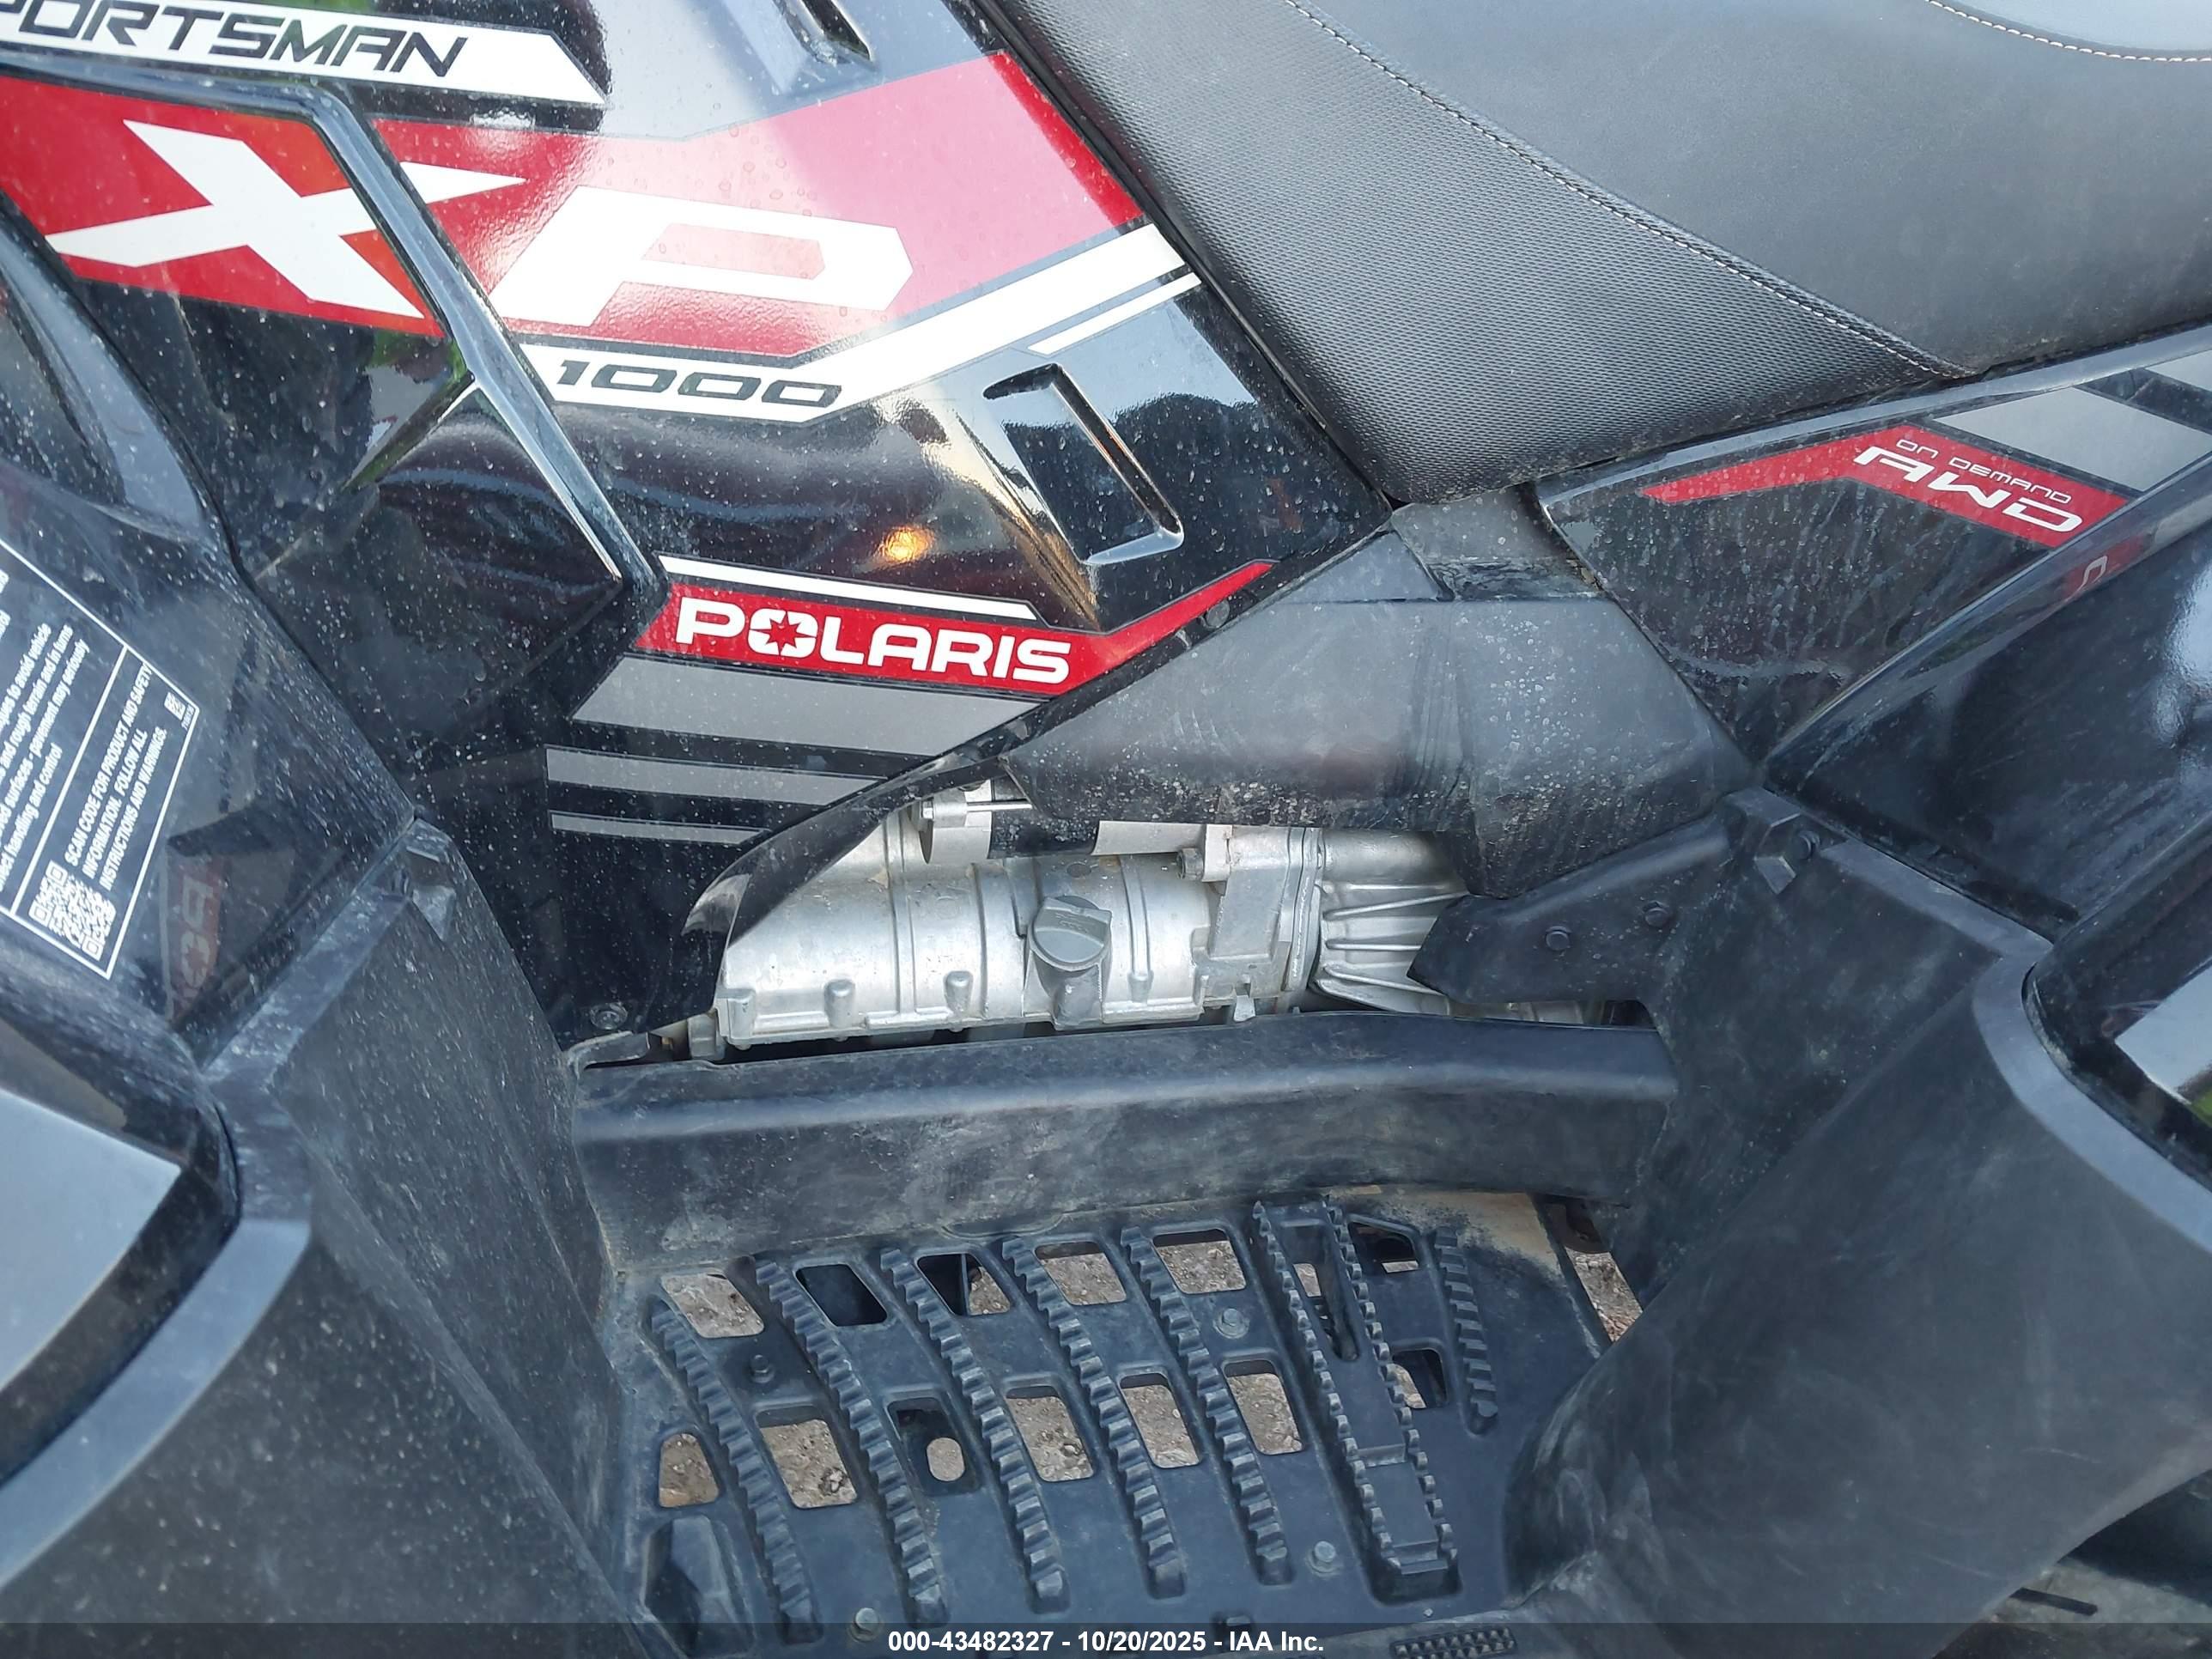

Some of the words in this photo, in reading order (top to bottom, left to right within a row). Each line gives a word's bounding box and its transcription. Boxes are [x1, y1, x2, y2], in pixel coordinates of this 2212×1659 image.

[44, 119, 914, 326] XP
[557, 360, 843, 409] 1000
[1853, 445, 2083, 533] AWD
[1895, 439, 1938, 459] ON
[1949, 459, 2073, 504] DEMAND
[46, 648, 62, 665] in
[52, 624, 74, 653] turns
[676, 597, 1071, 685] POLARIS
[6, 684, 21, 701] to
[14, 653, 35, 689] avoid
[27, 623, 52, 660] vehicle
[40, 657, 57, 684] and
[130, 662, 153, 705] SAFETY
[22, 678, 48, 715] terrain
[121, 699, 138, 727] AND
[4, 757, 33, 809] surfaces
[28, 701, 59, 758] pavement
[52, 680, 70, 708] may
[62, 638, 90, 686] seriously
[9, 711, 32, 748] rough
[0, 740, 17, 769] and
[100, 720, 130, 777] PRODUCT
[137, 726, 167, 785] WARNINGS.
[3, 803, 40, 858] handling
[28, 779, 46, 808] and
[39, 742, 63, 786] control
[82, 795, 123, 879] INFORMATION.
[113, 745, 140, 797] FOLLOW
[131, 728, 149, 752] ALL
[91, 770, 111, 800] FOR
[130, 781, 147, 809] AND
[78, 794, 101, 833] CODE
[64, 827, 88, 866] SCAN
[99, 804, 138, 891] INSTRUCTIONS
